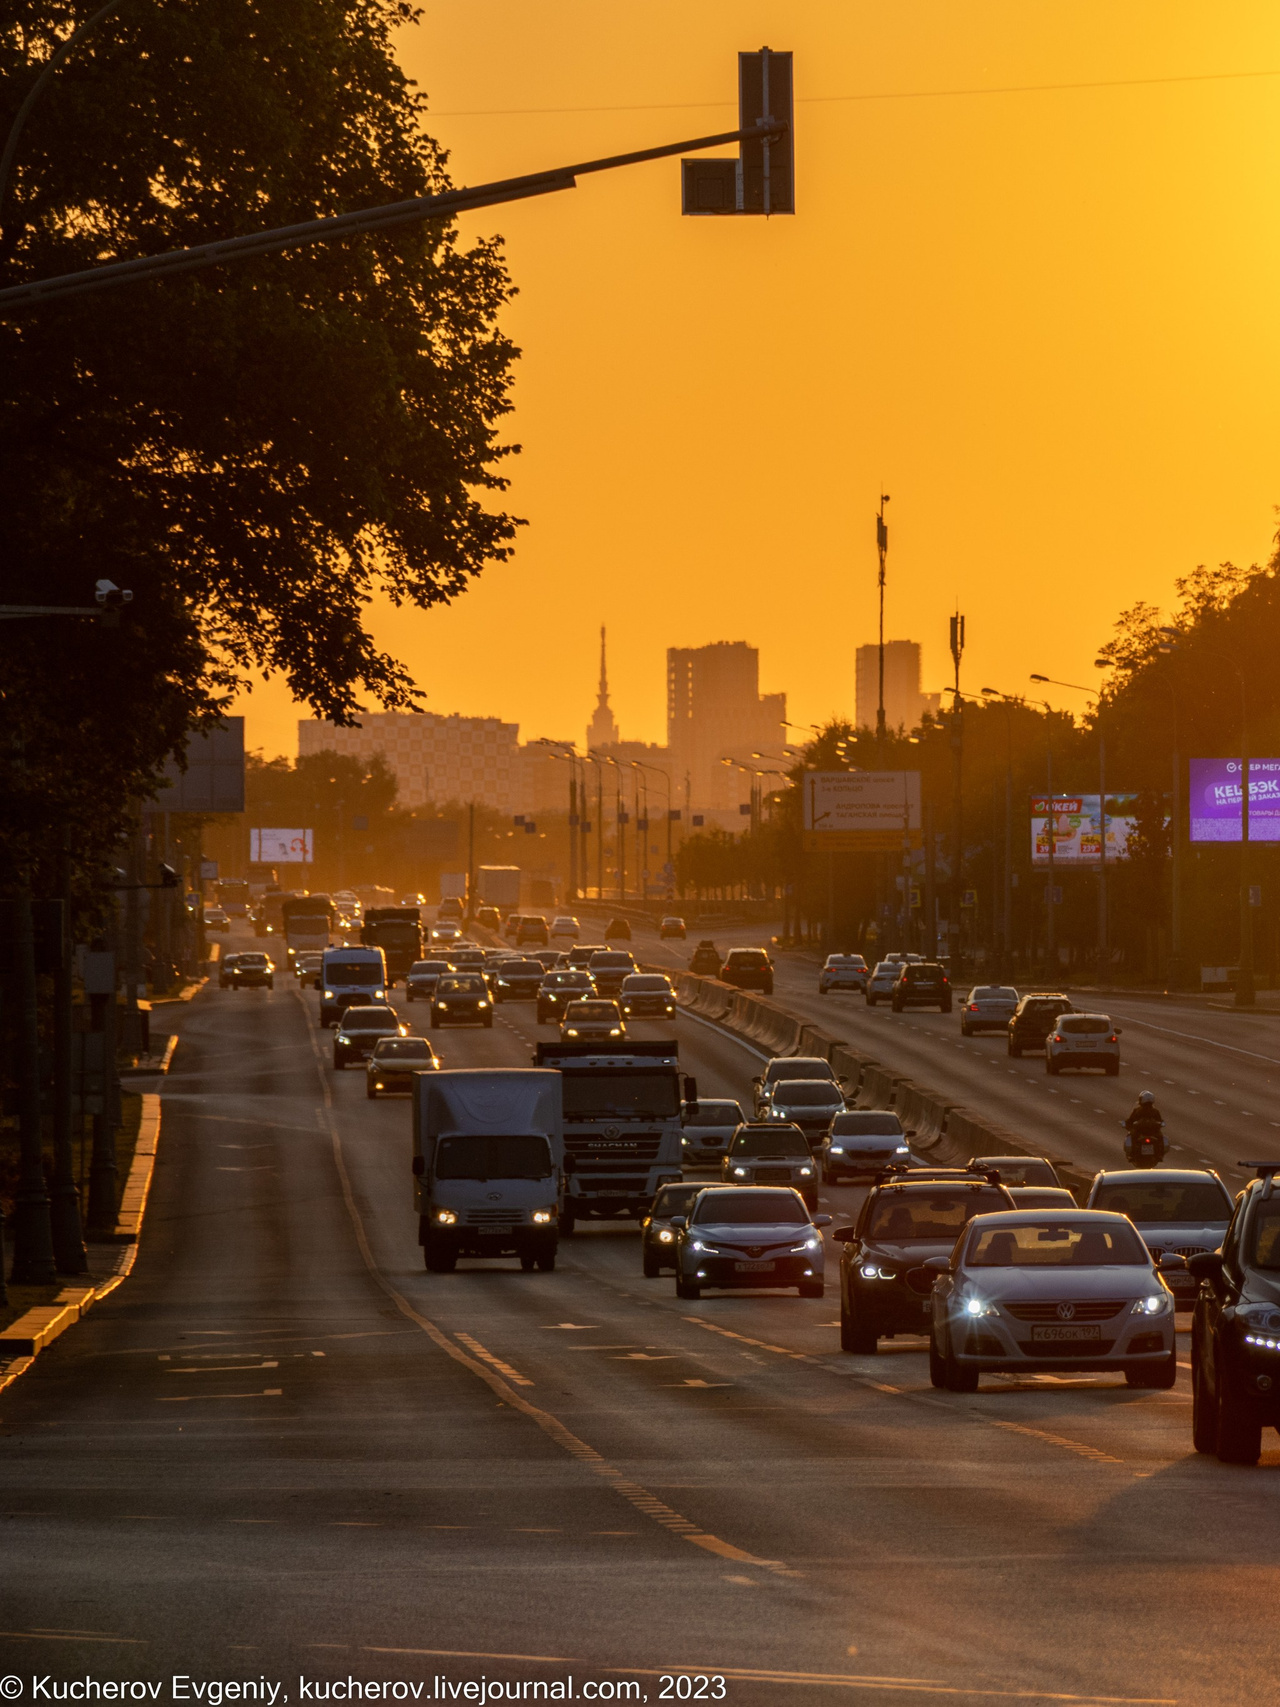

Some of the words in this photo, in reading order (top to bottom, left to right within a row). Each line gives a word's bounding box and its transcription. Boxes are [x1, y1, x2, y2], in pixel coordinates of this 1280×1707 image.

[1238, 763, 1261, 771] СЕР
[1216, 798, 1228, 806] НА
[1227, 794, 1257, 804] ПЕРЙ
[1258, 792, 1280, 801] ЗАКАЗ
